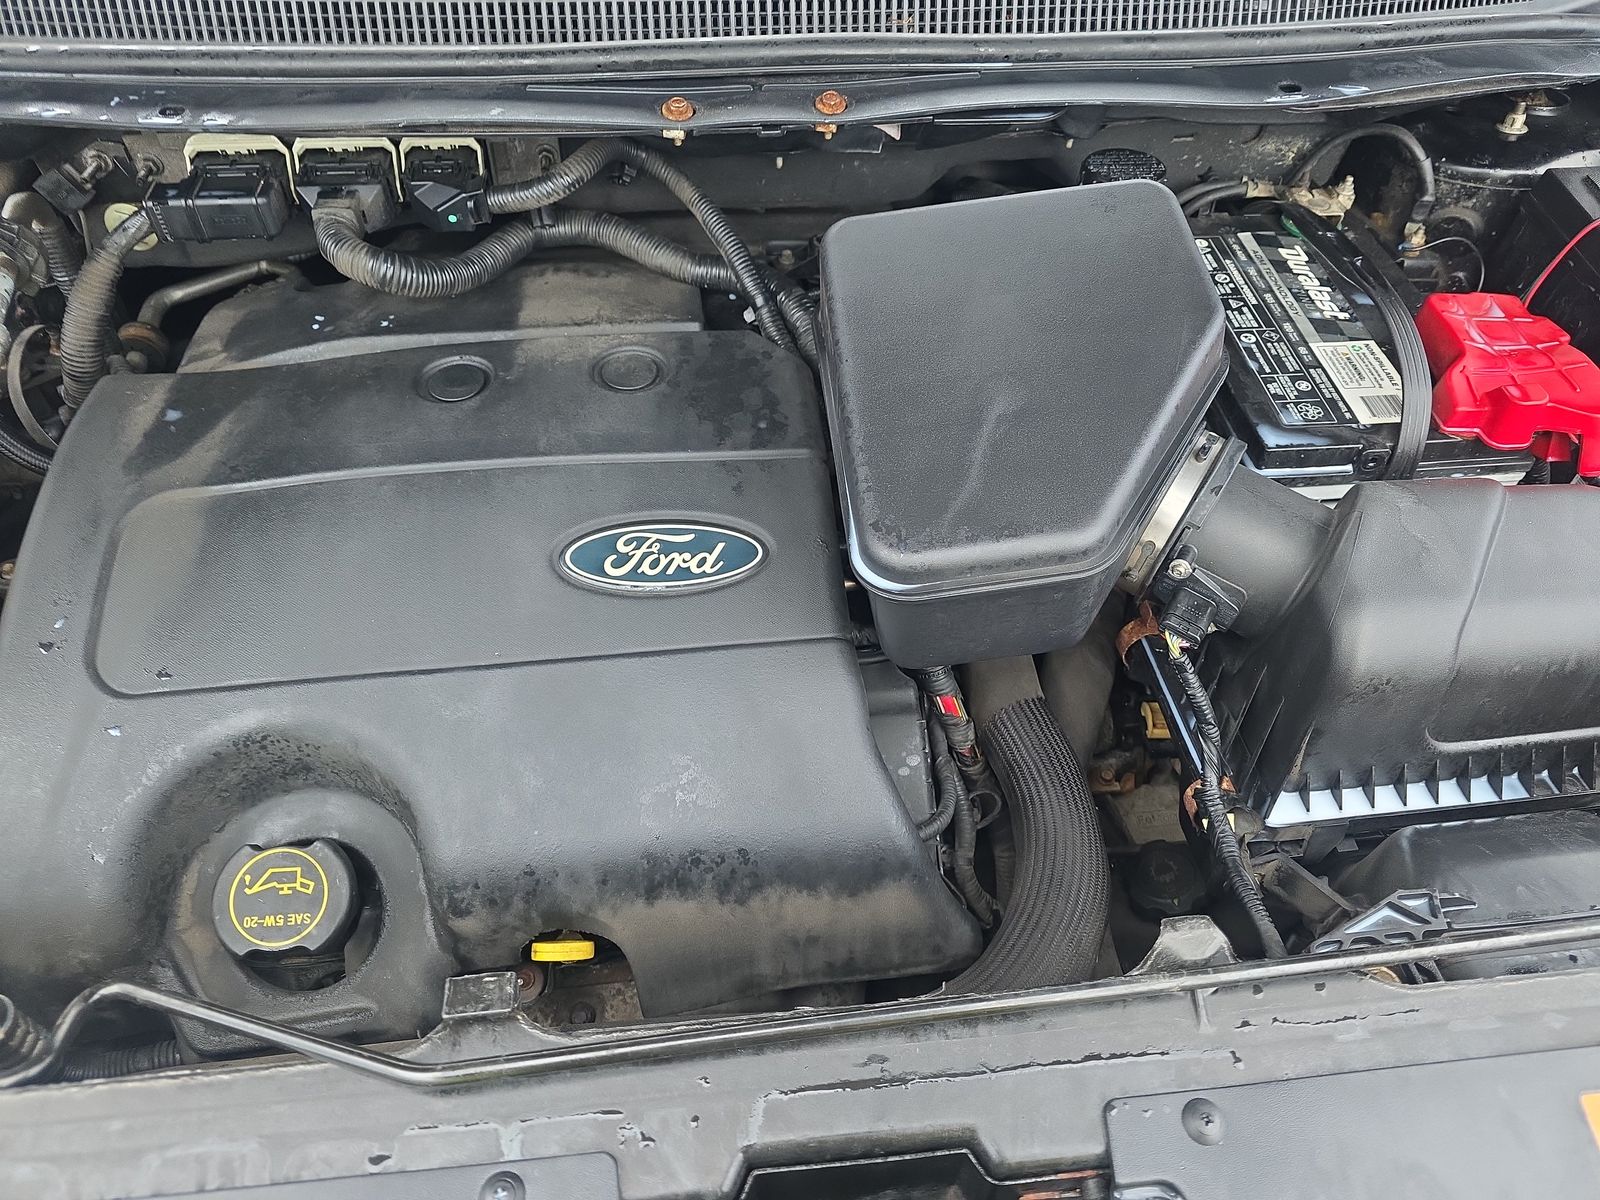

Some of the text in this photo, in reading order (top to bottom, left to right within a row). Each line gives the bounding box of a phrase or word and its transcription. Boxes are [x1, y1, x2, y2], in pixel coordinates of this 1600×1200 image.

[1252, 249, 1268, 266] AGM
[1264, 267, 1302, 317] TECHNOLOGY
[1277, 245, 1351, 320] Duralast
[603, 532, 726, 577] Ford
[243, 913, 311, 929] SAE 5W-20
